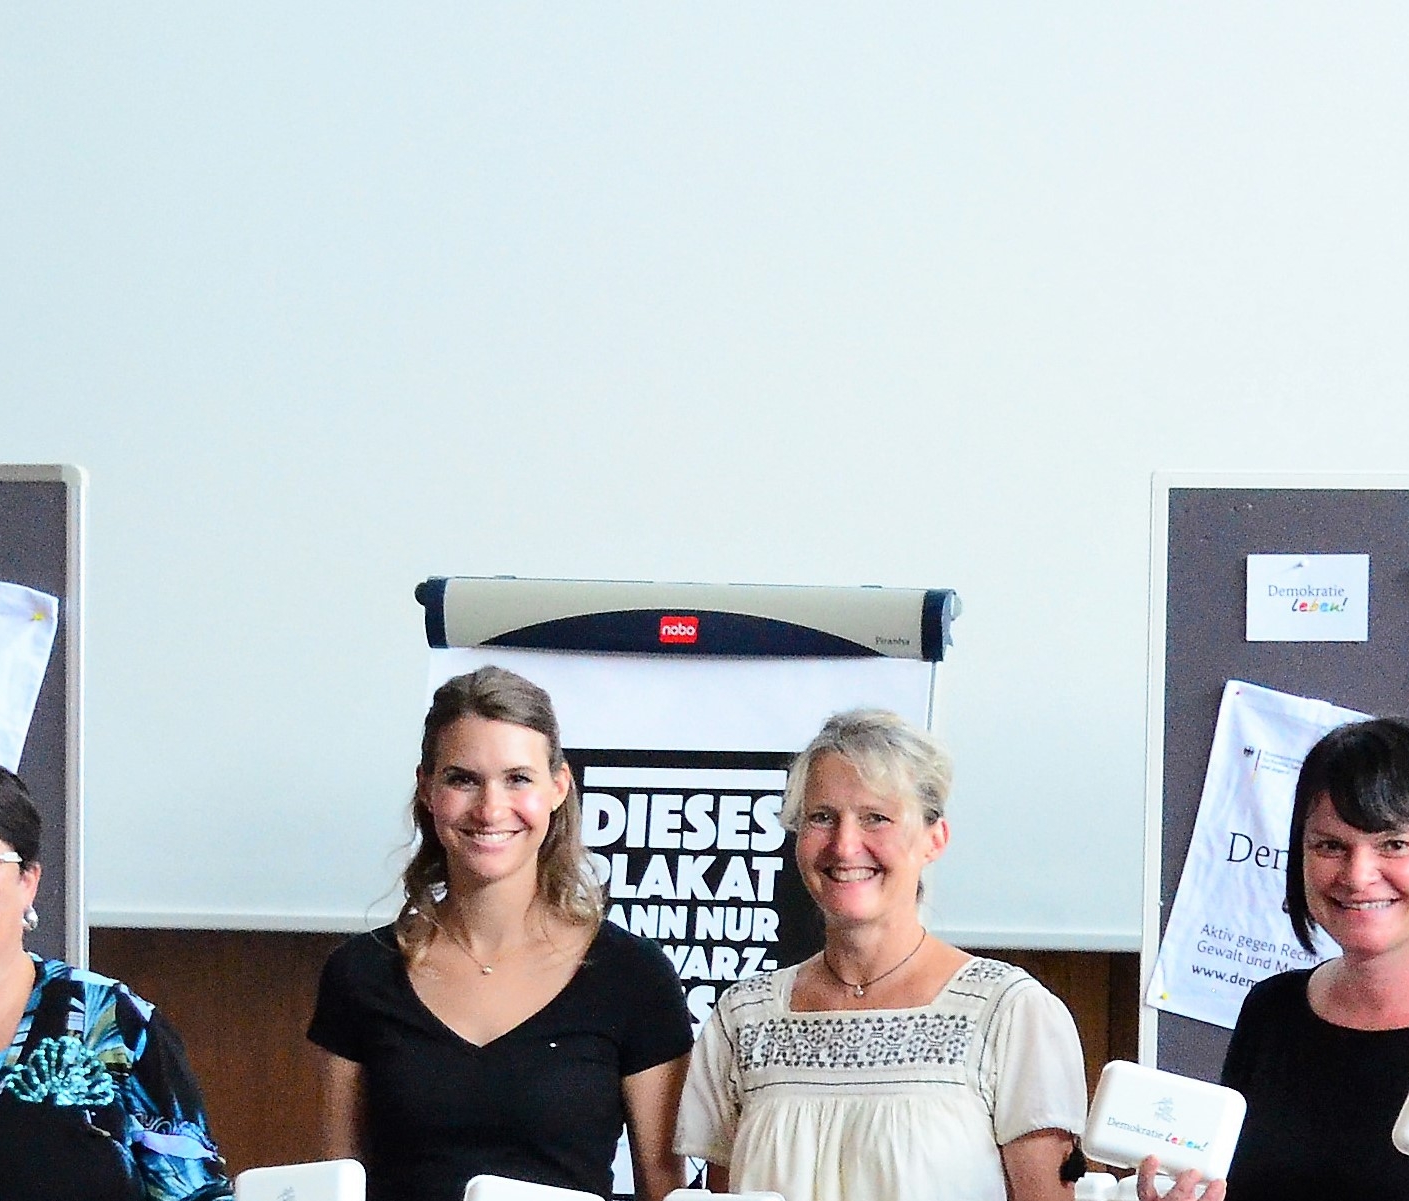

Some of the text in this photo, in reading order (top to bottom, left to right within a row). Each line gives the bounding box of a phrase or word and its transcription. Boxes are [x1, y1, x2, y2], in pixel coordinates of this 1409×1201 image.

[1268, 584, 1345, 597] Demokratie
[1292, 598, 1348, 612] leben!
[662, 624, 696, 636] nobo
[581, 793, 786, 851] DIESES
[606, 904, 779, 942] ANN NUR
[1200, 923, 1234, 941] Aktiv
[1236, 935, 1276, 953] gegen
[1197, 939, 1243, 962] Gewalt
[1246, 955, 1272, 970] und
[1107, 1117, 1209, 1152] Demokratie leben!
